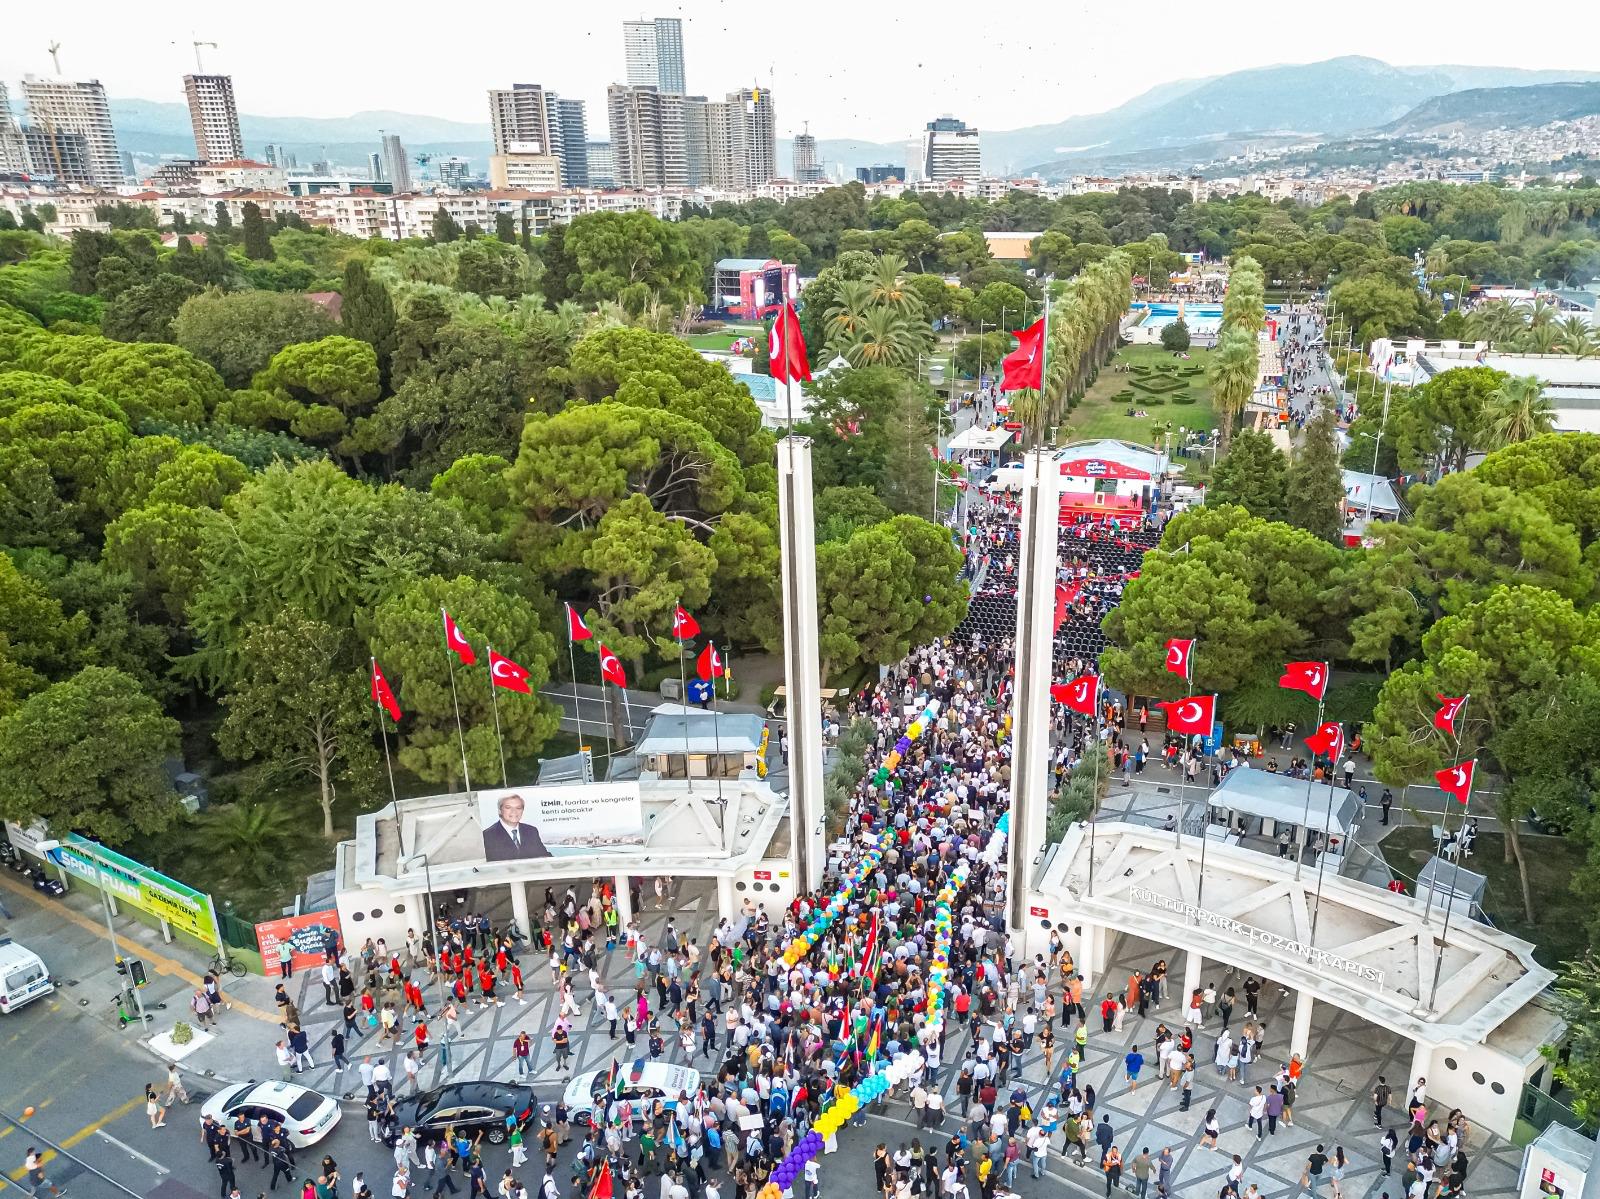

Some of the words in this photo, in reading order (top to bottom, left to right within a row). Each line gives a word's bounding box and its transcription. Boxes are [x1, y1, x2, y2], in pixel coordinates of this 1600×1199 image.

[600, 796, 634, 804] kongreler
[61, 851, 97, 880] SPOR
[100, 870, 141, 902] FUARI
[1319, 952, 1385, 984] KAPISI
